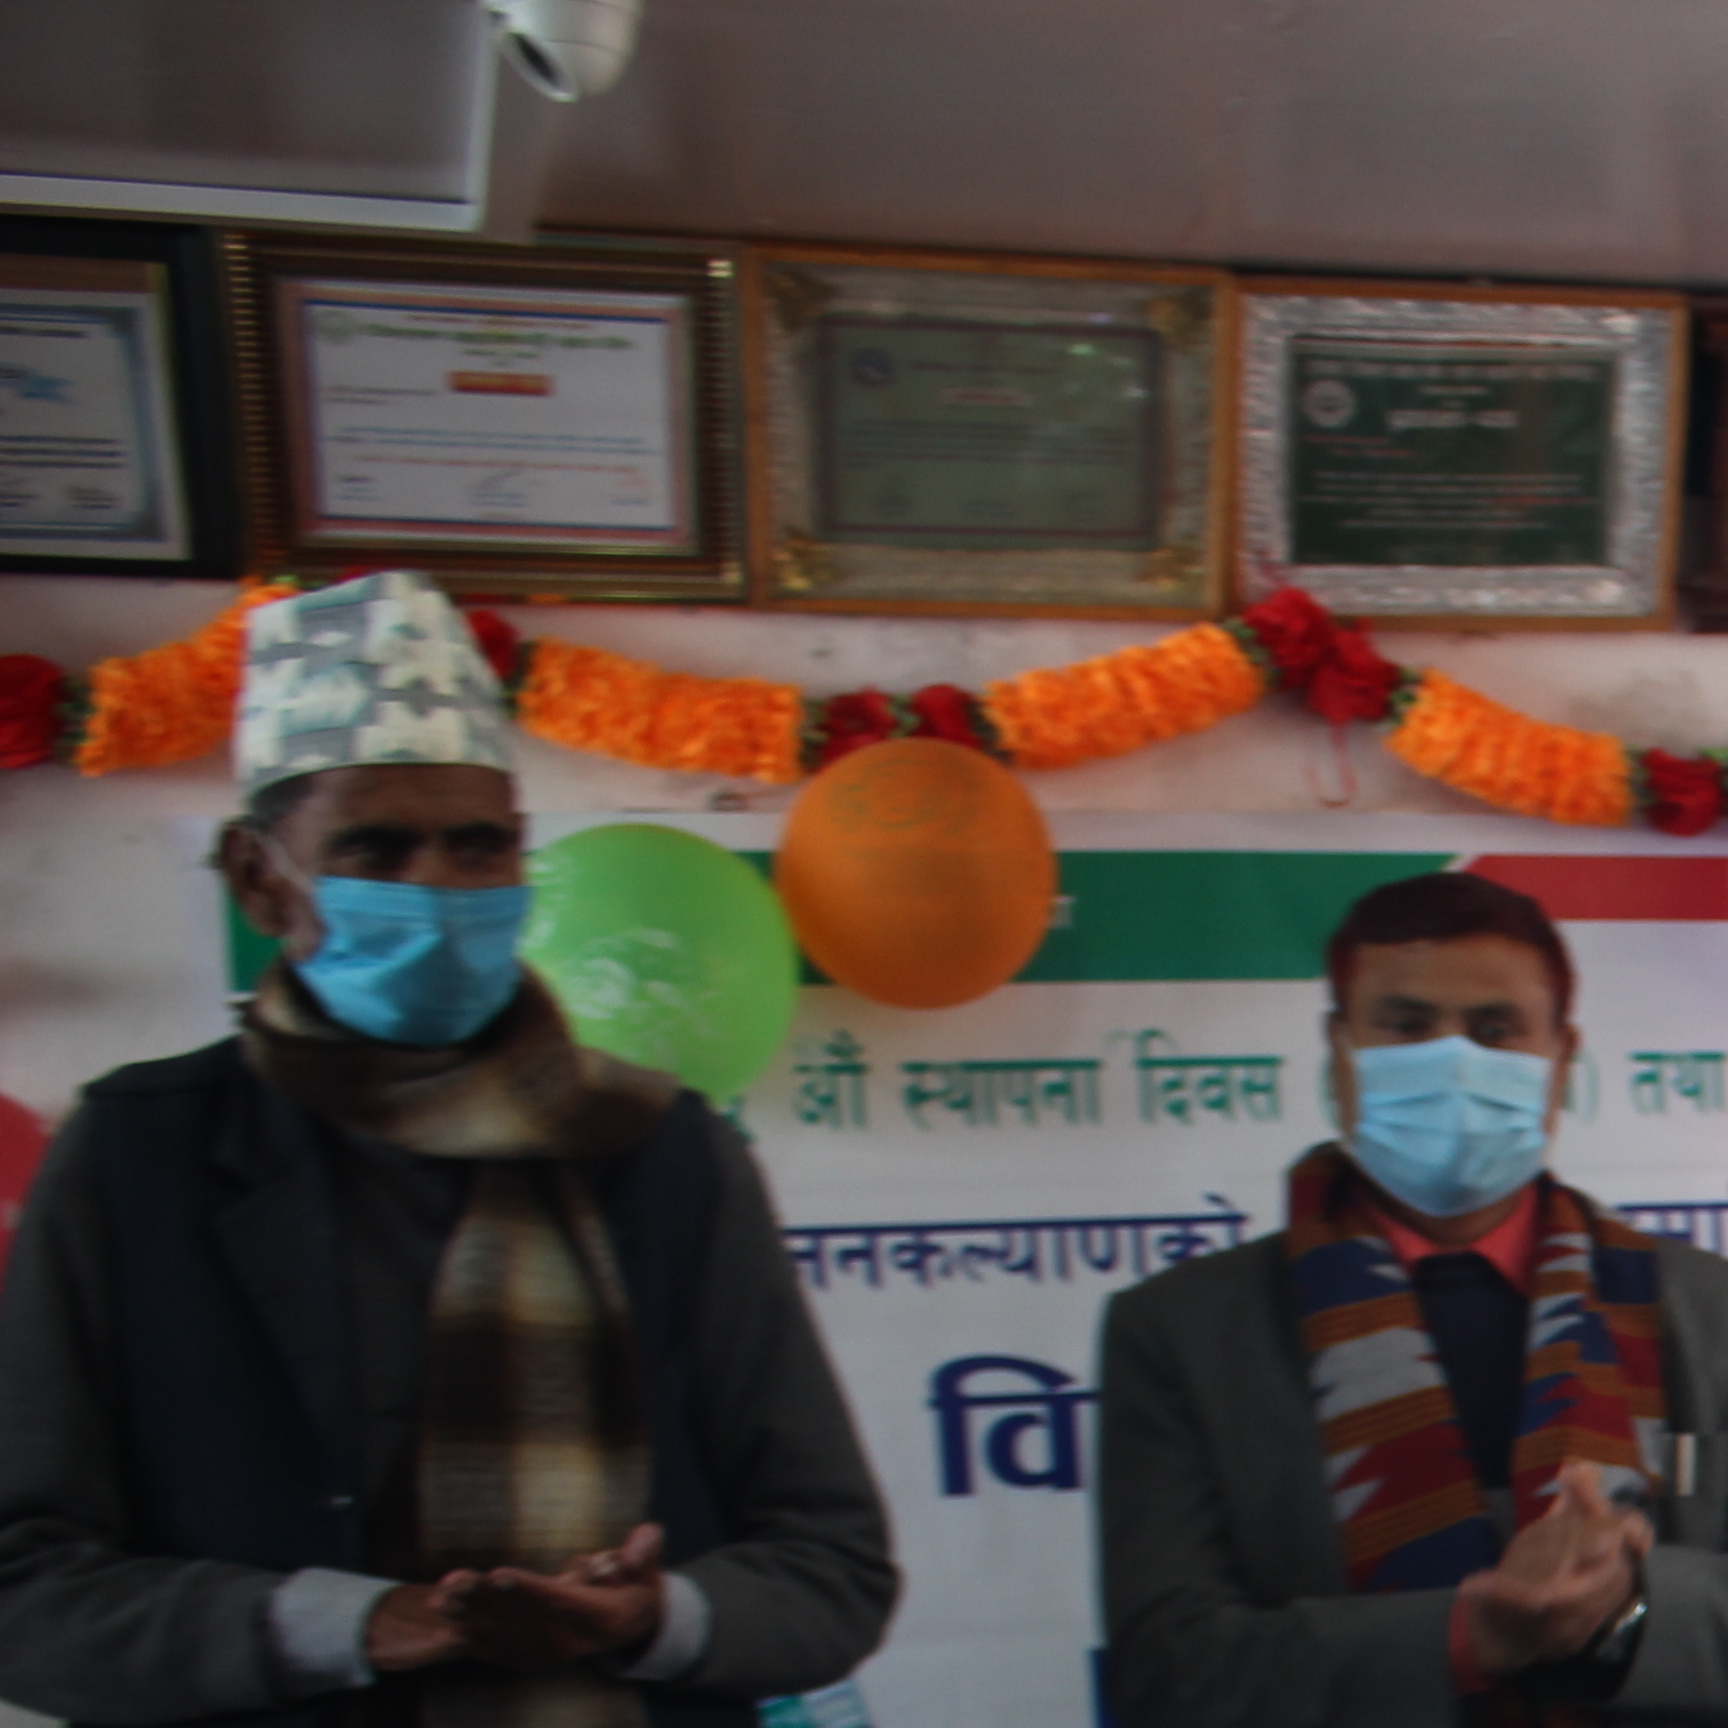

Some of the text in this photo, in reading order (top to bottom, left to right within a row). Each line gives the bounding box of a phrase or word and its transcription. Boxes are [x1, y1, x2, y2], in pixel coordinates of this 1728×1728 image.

[897, 1058, 1103, 1128] स्थापना
[1130, 1028, 1285, 1125] दिवस
[1627, 1050, 1728, 1115] तथा
